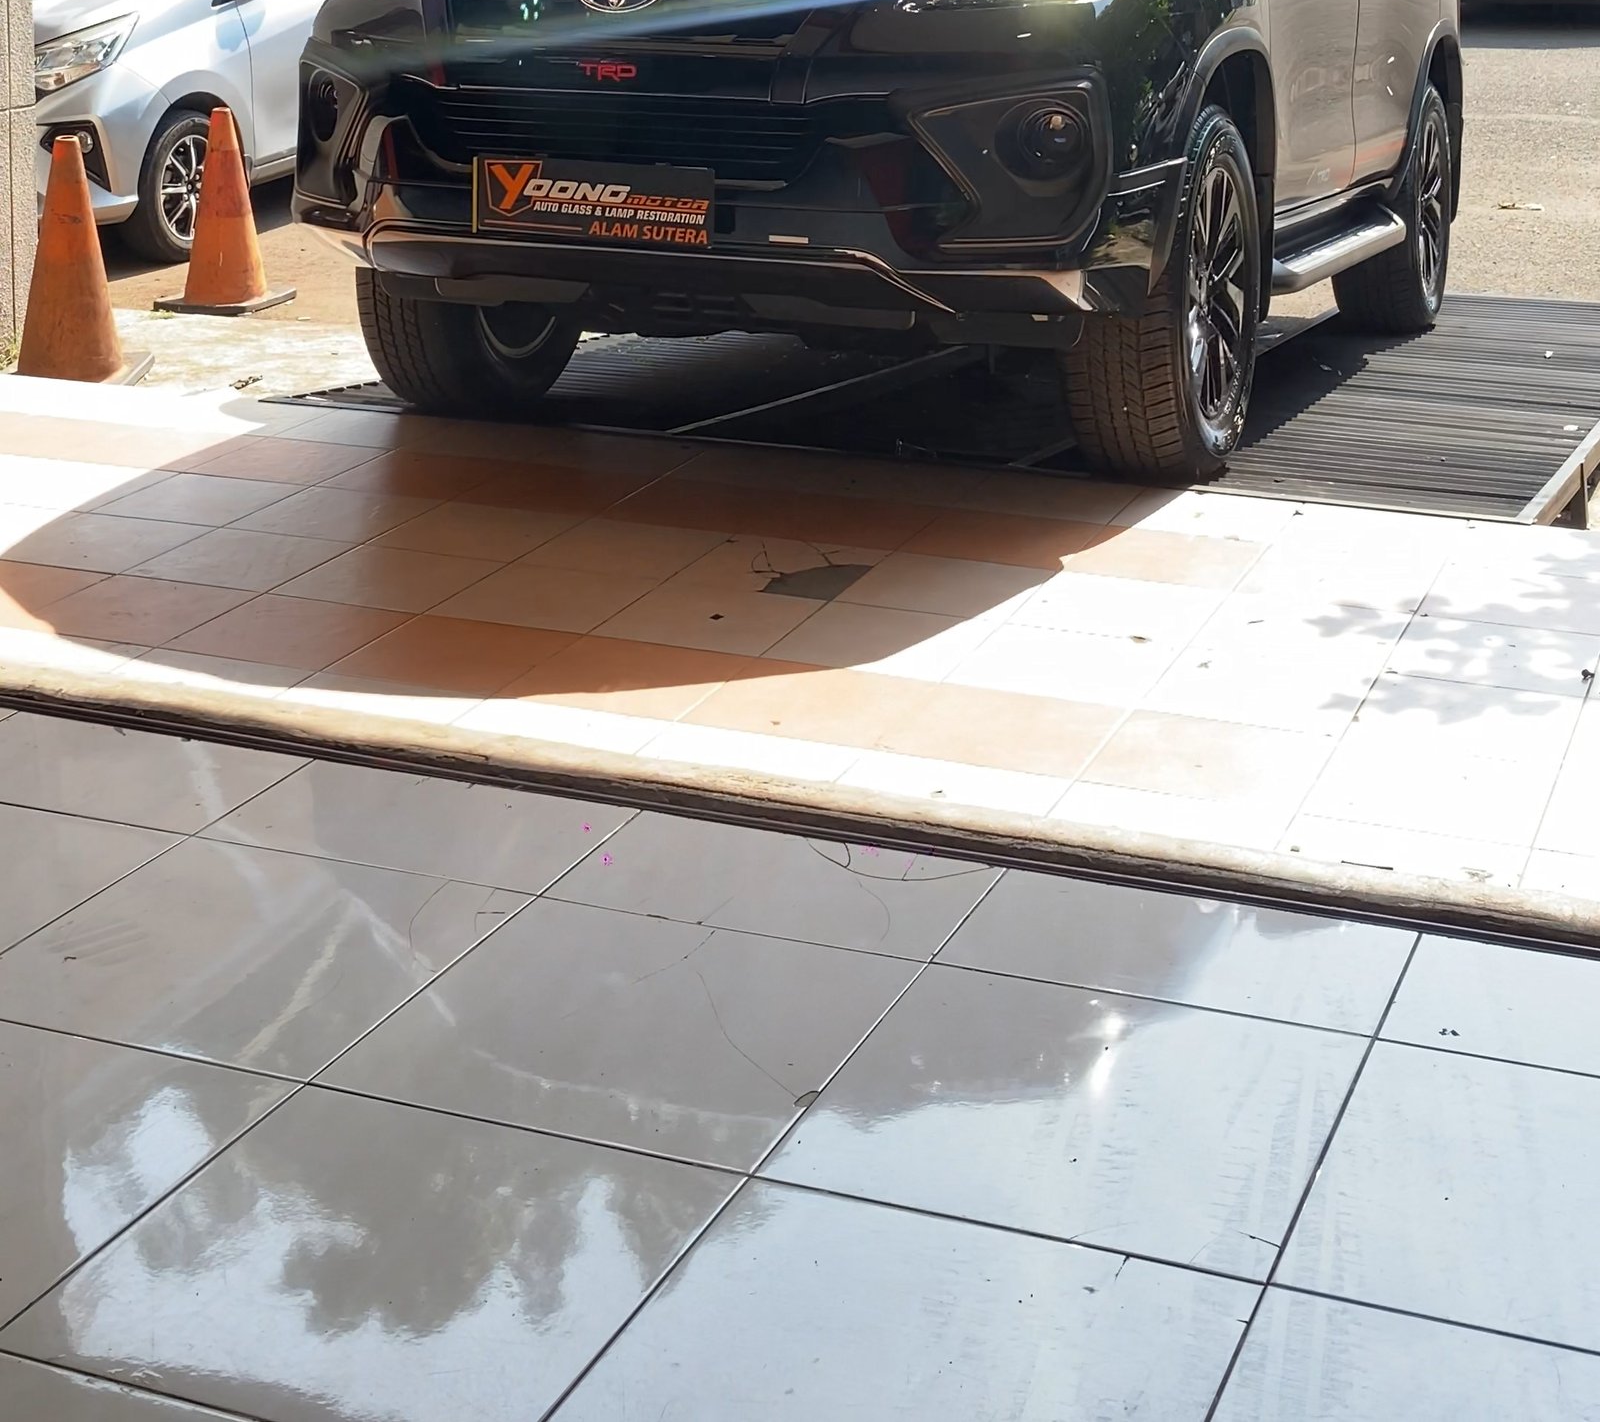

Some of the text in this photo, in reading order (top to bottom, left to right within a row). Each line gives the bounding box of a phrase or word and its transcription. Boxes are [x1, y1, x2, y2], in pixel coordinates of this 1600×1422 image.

[579, 61, 637, 81] TRD
[489, 163, 631, 210] YOONG
[533, 201, 705, 225] AUTO GLASS & LAMP RESTORATION
[588, 221, 708, 245] ALAM SUTERA
